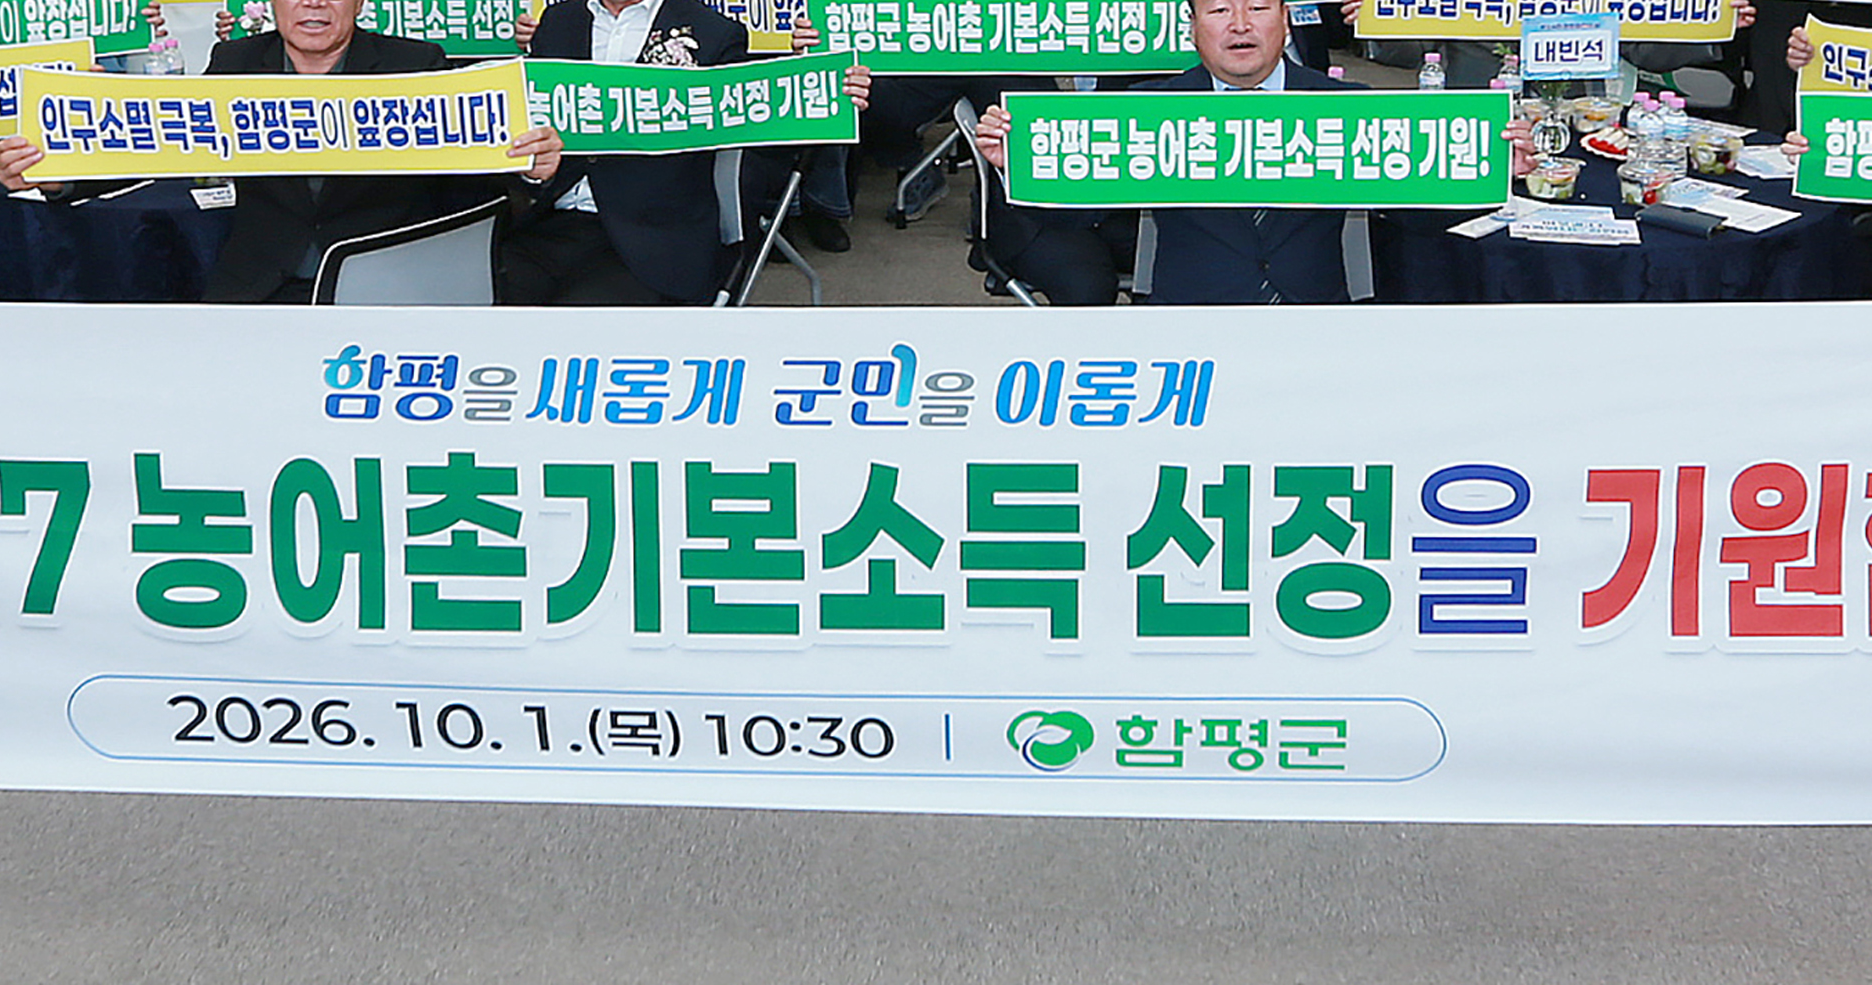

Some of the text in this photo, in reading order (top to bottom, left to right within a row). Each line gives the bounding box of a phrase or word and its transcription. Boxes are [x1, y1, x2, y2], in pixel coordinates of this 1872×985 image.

[384, 0, 517, 41] 기본소득 선정
[825, 2, 901, 54] 함평군
[907, 0, 983, 54] 농어촌
[988, 0, 1091, 54] 기본소득
[1095, 0, 1148, 54] 선정
[1533, 38, 1605, 64] 내빈석
[42, 90, 509, 159] 인구소멸 극복, 함평군이 앞장섭니다!
[528, 70, 840, 135] 농어촌 기본소득 선정 기원!
[1029, 117, 1490, 180] 함평군 농어촌 기본소득 선정 기원!
[323, 344, 1216, 427] 함평을 새롭게 군민을 이롭게
[131, 450, 1087, 638] 농어촌기본소득
[1126, 462, 1535, 638] 선정을
[169, 697, 373, 748] 2026.
[396, 701, 502, 751] 10.
[705, 712, 896, 760] 10:30
[1114, 714, 1351, 773] 함평군
